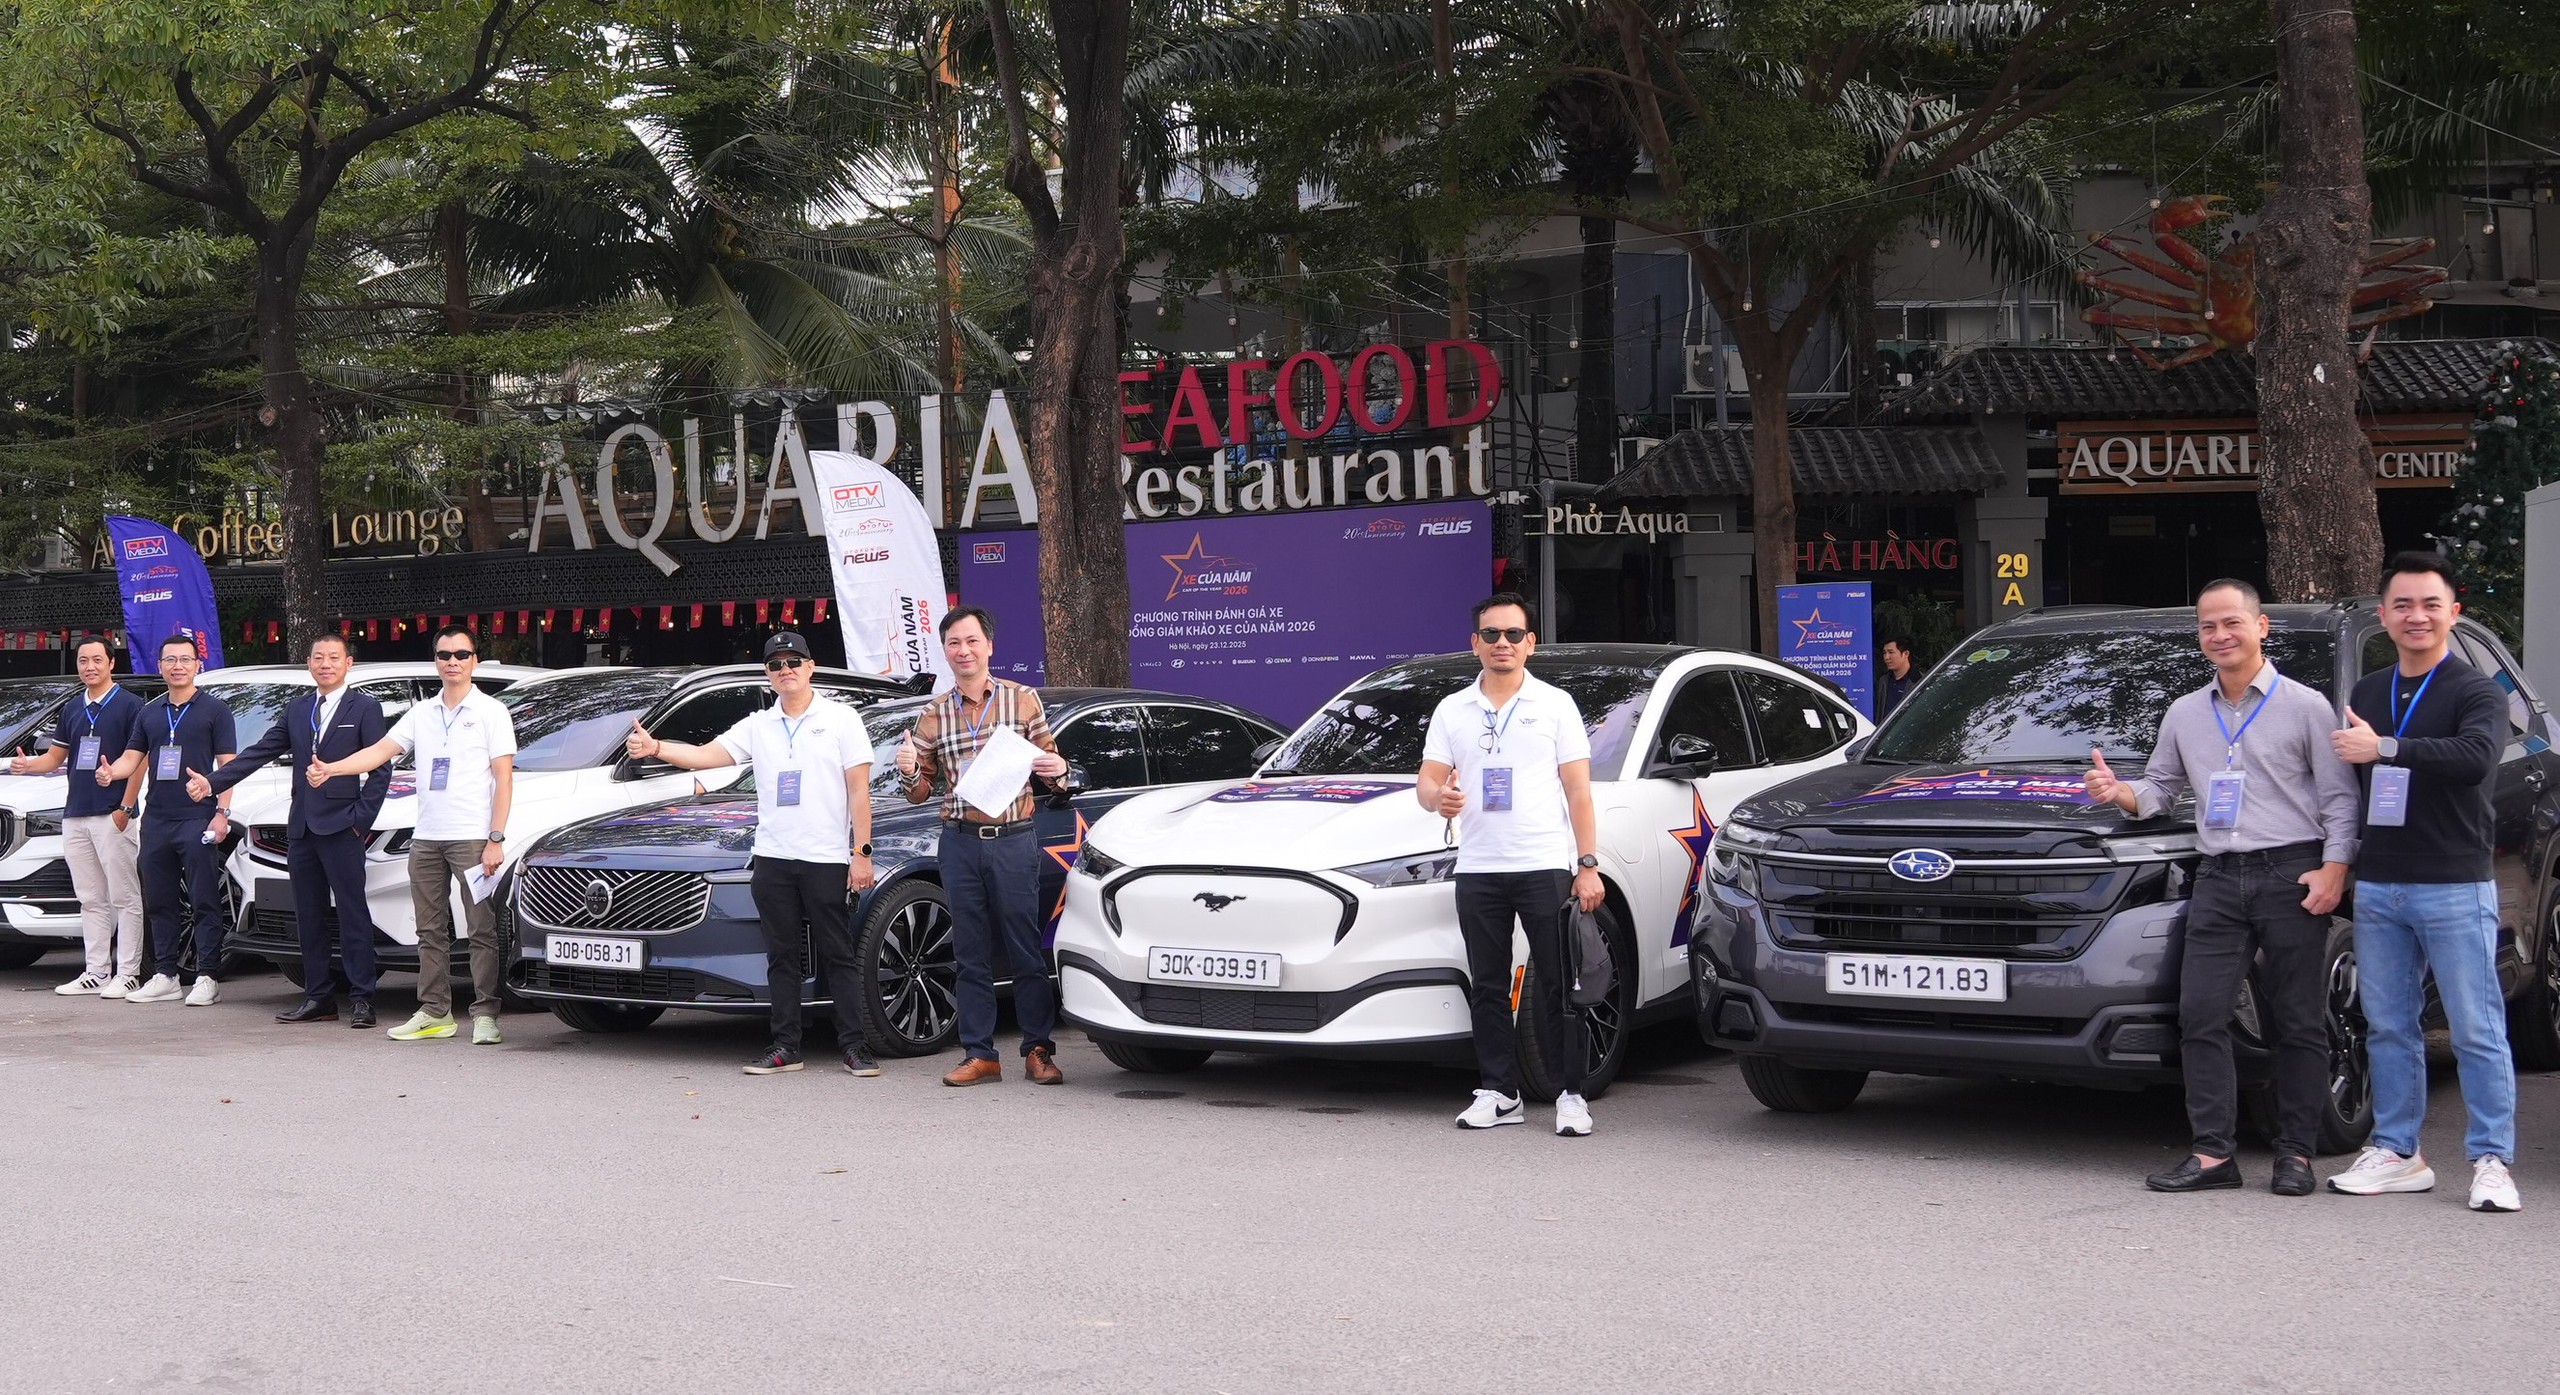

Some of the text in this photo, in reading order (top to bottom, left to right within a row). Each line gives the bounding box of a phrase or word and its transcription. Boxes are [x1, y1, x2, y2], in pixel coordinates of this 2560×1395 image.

[1118, 339, 1501, 453] EAFOOD
[2068, 435, 2260, 487] AQUARI
[2379, 451, 2460, 478] CENTR
[834, 485, 878, 500] OTV
[836, 496, 883, 510] MEDIA
[332, 505, 465, 556] Lounge
[1546, 503, 1690, 544] Phở Aqua
[129, 547, 166, 556] MEDIA
[976, 545, 1002, 554] OTV
[1852, 530, 1958, 570] HÀNG
[1182, 570, 1252, 585] XE CỦA NĂM
[1997, 553, 2029, 578] 29
[1223, 586, 1248, 595] 2026
[2002, 582, 2025, 606] A
[900, 596, 916, 636] NĂM
[918, 600, 931, 634] 2026
[1134, 606, 1283, 623] CHƯƠNG TRÌNH ĐÁNH GIÁ XE
[1156, 624, 1183, 636] GIÁM
[1186, 622, 1216, 635] KHẢO
[1218, 624, 1232, 635] XE
[1235, 620, 1257, 634] CỦA
[1260, 620, 1284, 633] NĂM
[1287, 621, 1316, 632] 2026
[196, 631, 208, 659] 2026
[1209, 641, 1246, 649] 23.12.2025
[1160, 954, 1267, 980] 30K-039.91
[1842, 962, 1988, 992] 51M-121.83
